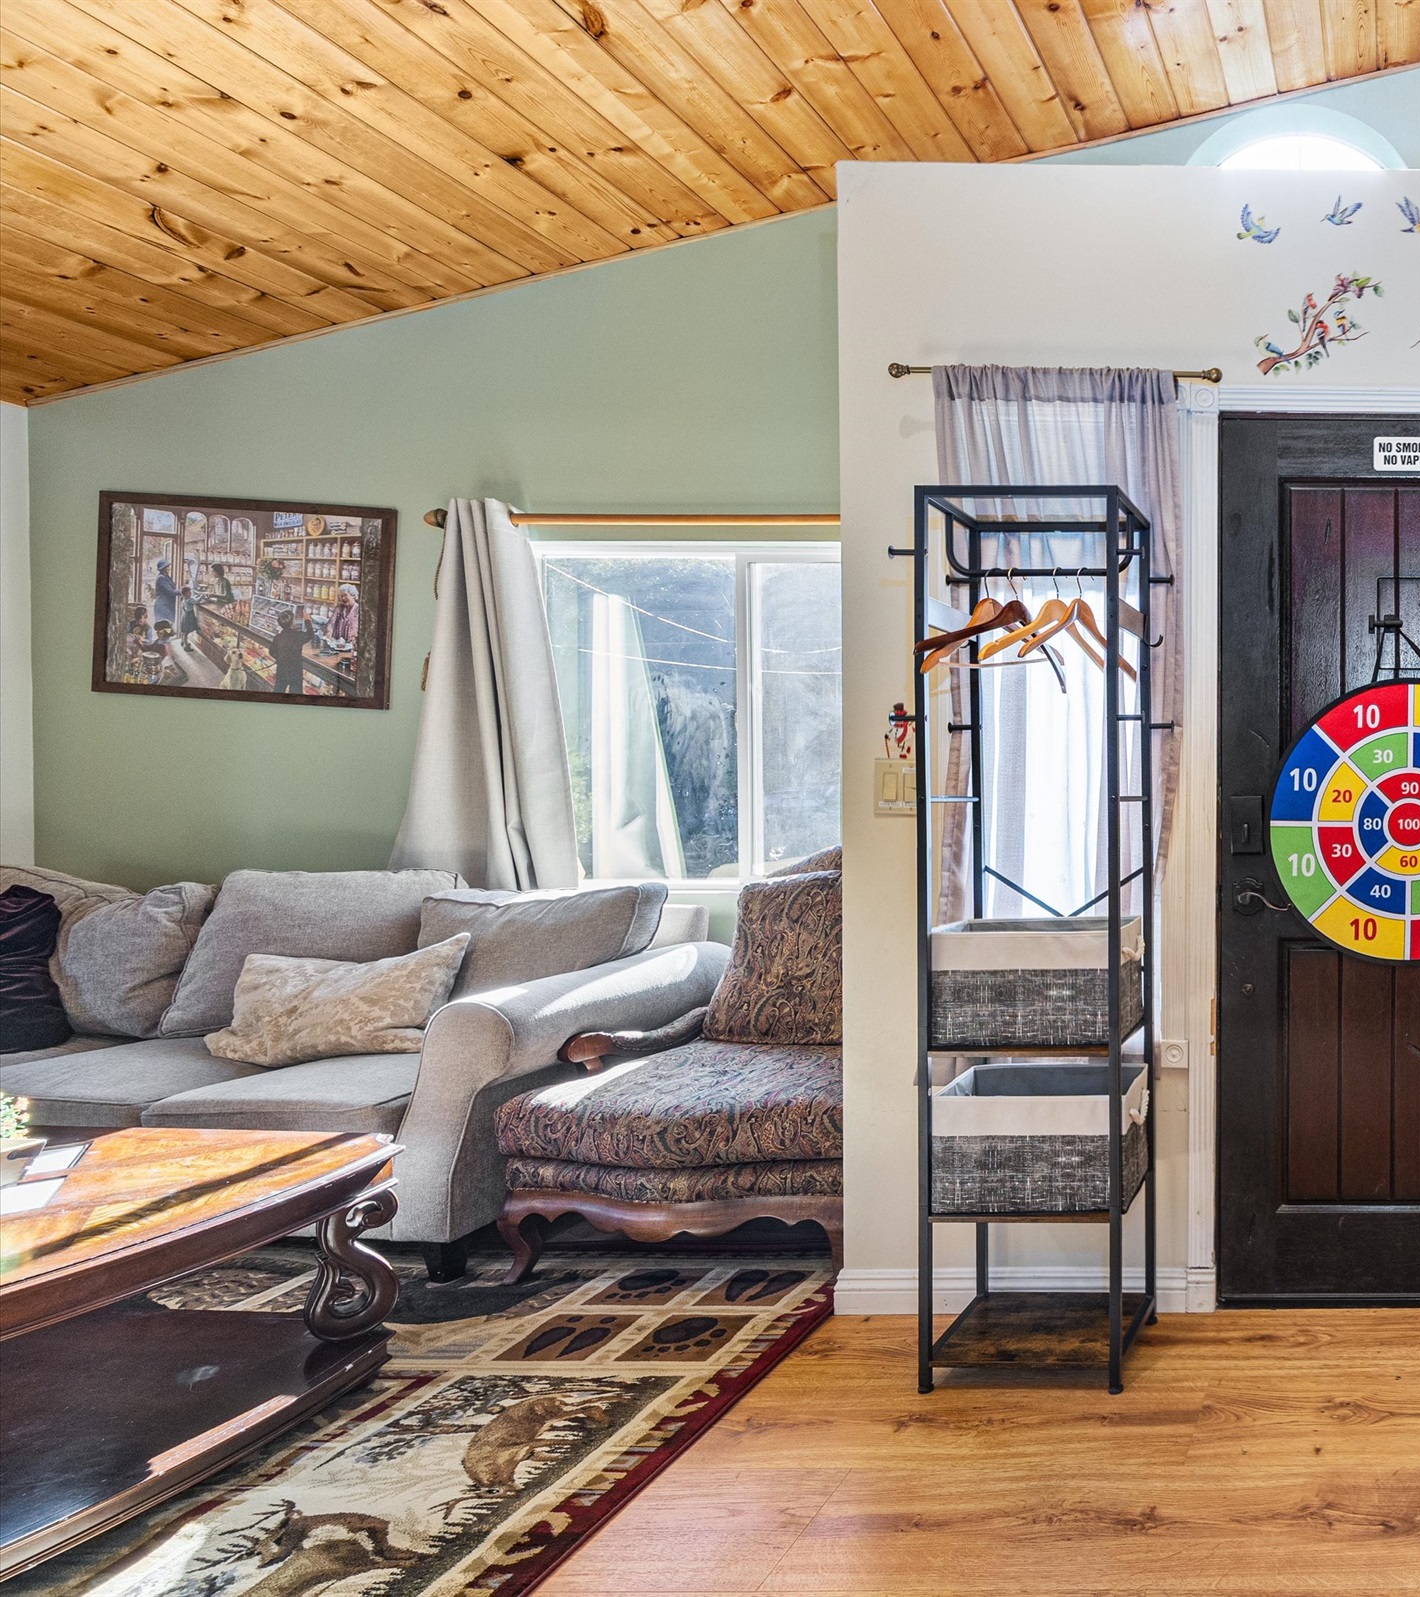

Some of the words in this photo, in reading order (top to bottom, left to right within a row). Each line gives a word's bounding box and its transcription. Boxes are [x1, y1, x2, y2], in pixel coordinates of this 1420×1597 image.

[1378, 442, 1392, 453] NO
[1383, 455, 1398, 465] NO
[1353, 705, 1380, 728] 10
[1373, 750, 1393, 764] 30
[1290, 768, 1317, 791] 10
[1401, 782, 1419, 794] 90
[1332, 789, 1352, 803] 20
[1364, 818, 1381, 831] 80
[1398, 819, 1420, 830] 100
[1331, 844, 1352, 858] 30
[1288, 853, 1315, 877] 10
[1400, 856, 1418, 868] 60
[1370, 884, 1391, 898] 40
[1350, 918, 1377, 941] 10
